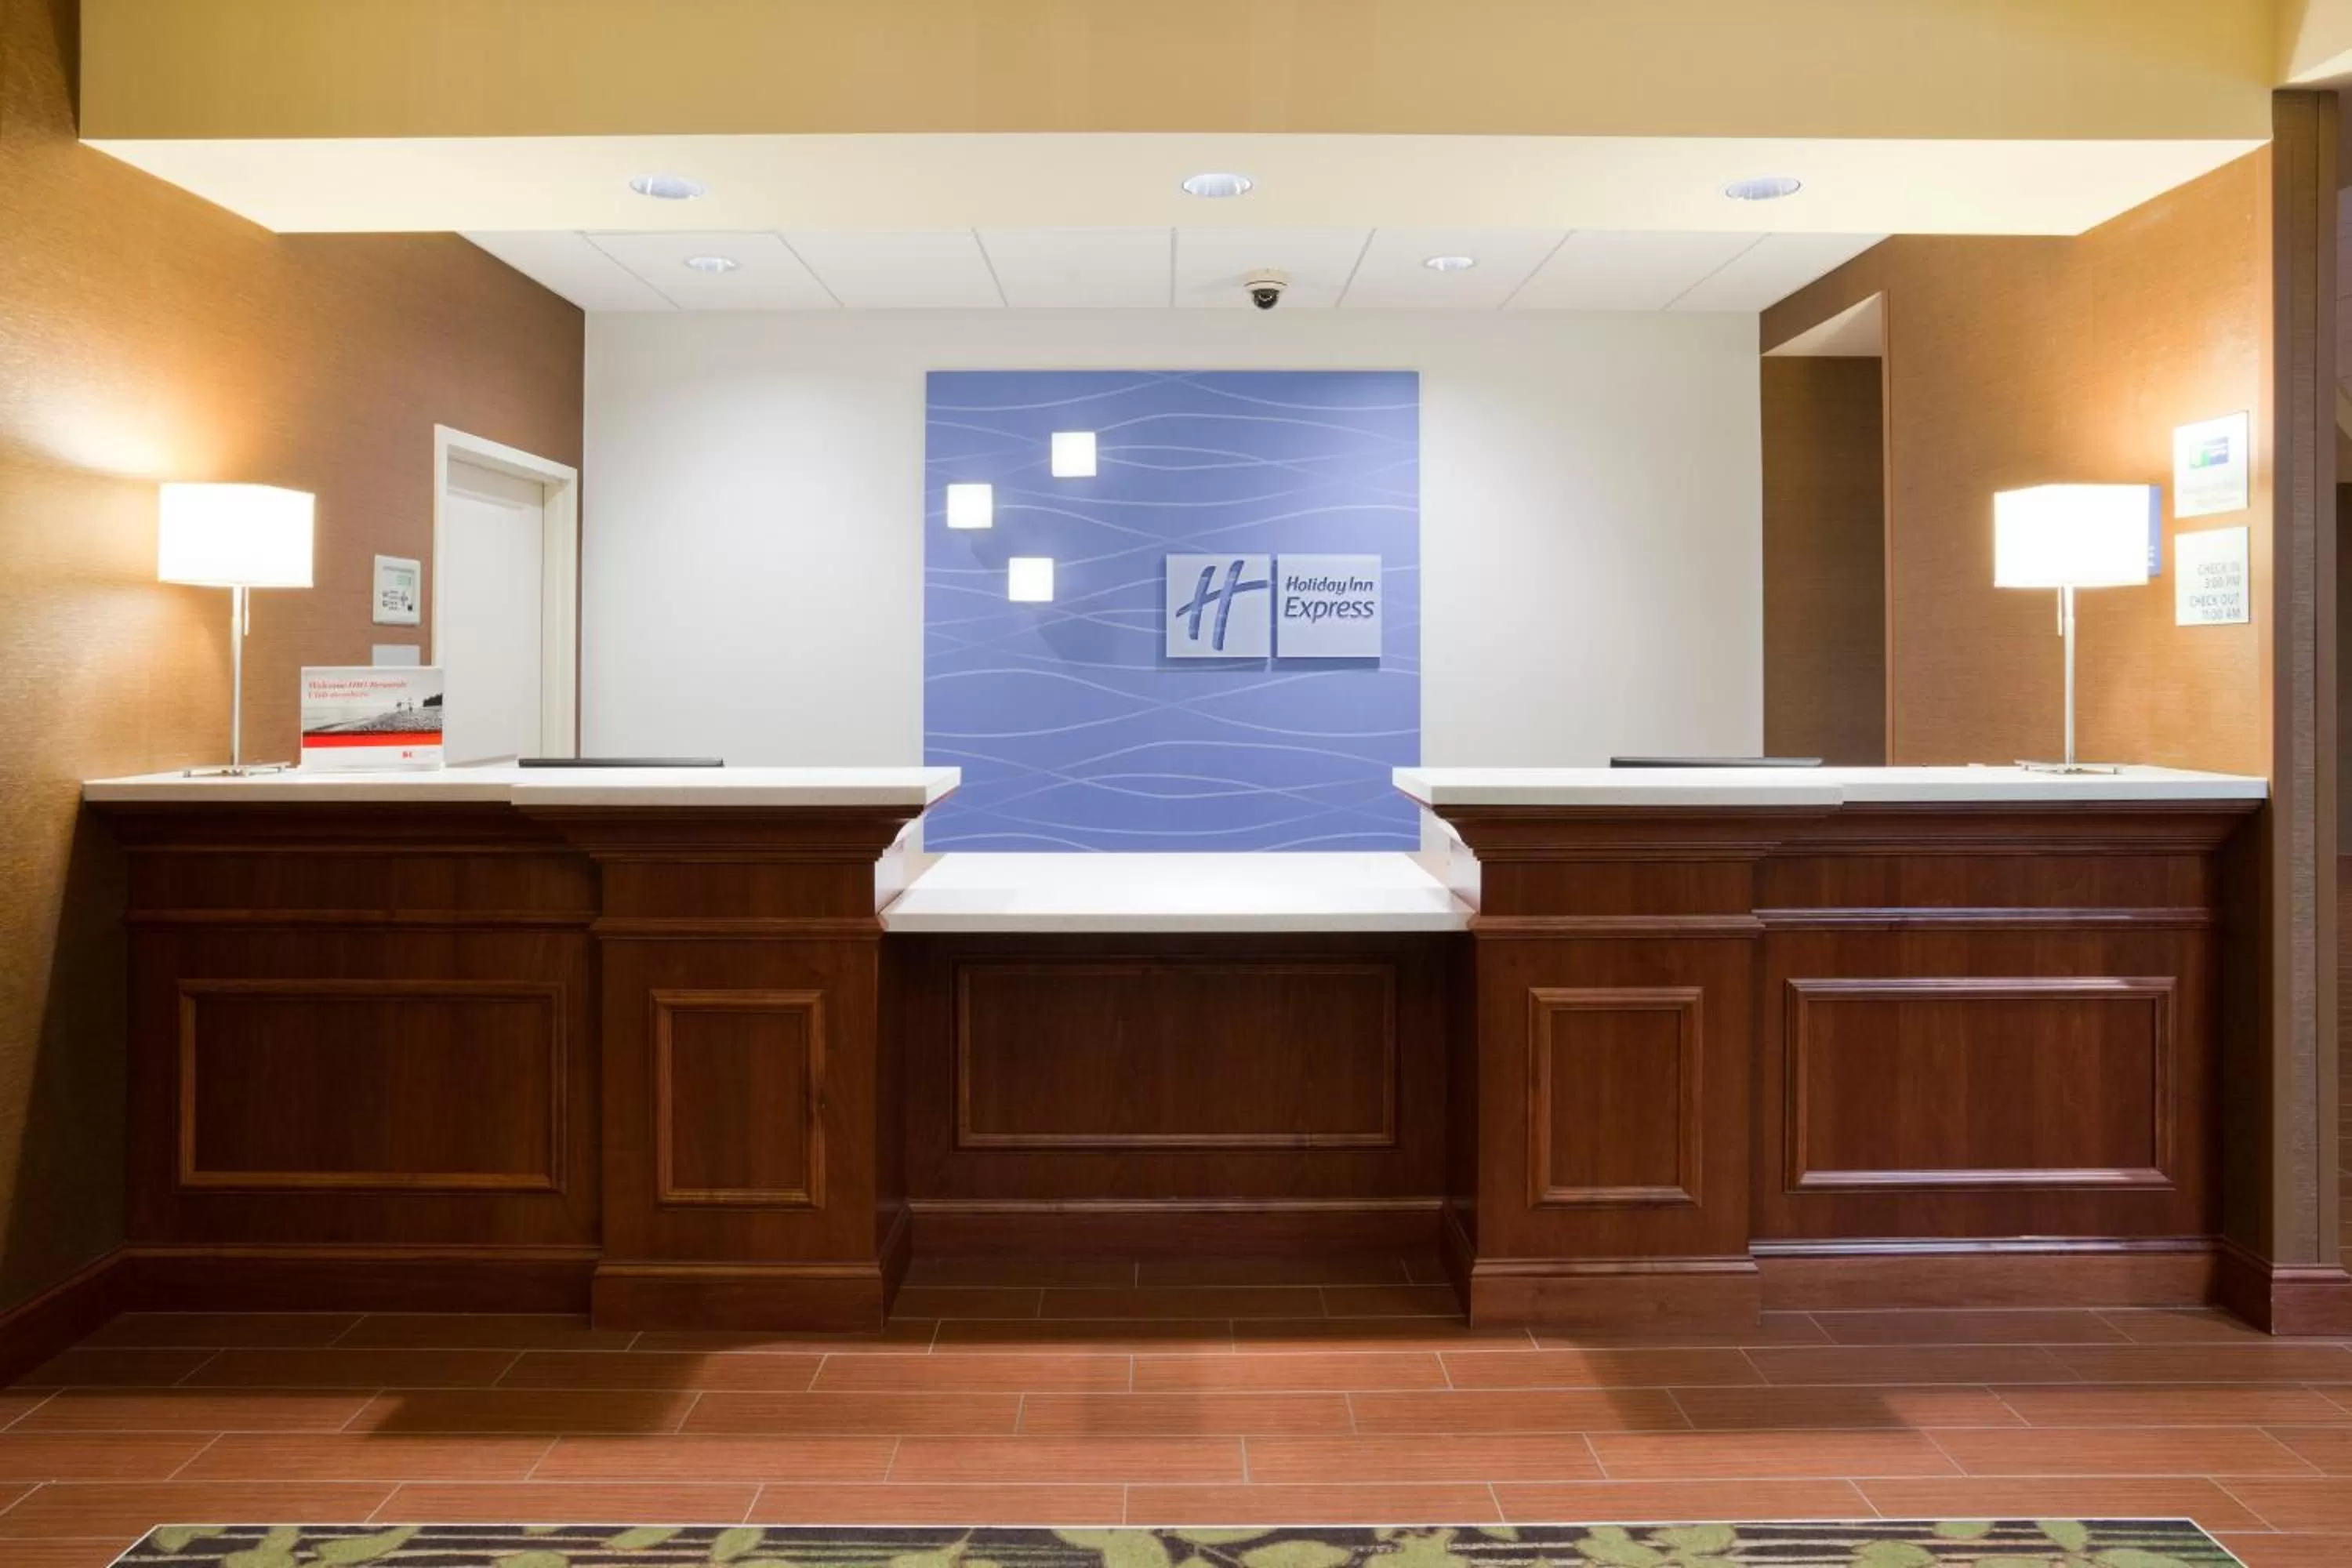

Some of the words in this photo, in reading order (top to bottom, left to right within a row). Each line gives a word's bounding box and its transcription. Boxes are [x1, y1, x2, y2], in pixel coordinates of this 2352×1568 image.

[1286, 576, 1346, 595] Holiday
[1349, 576, 1374, 591] Inn
[1284, 596, 1374, 623] Express
